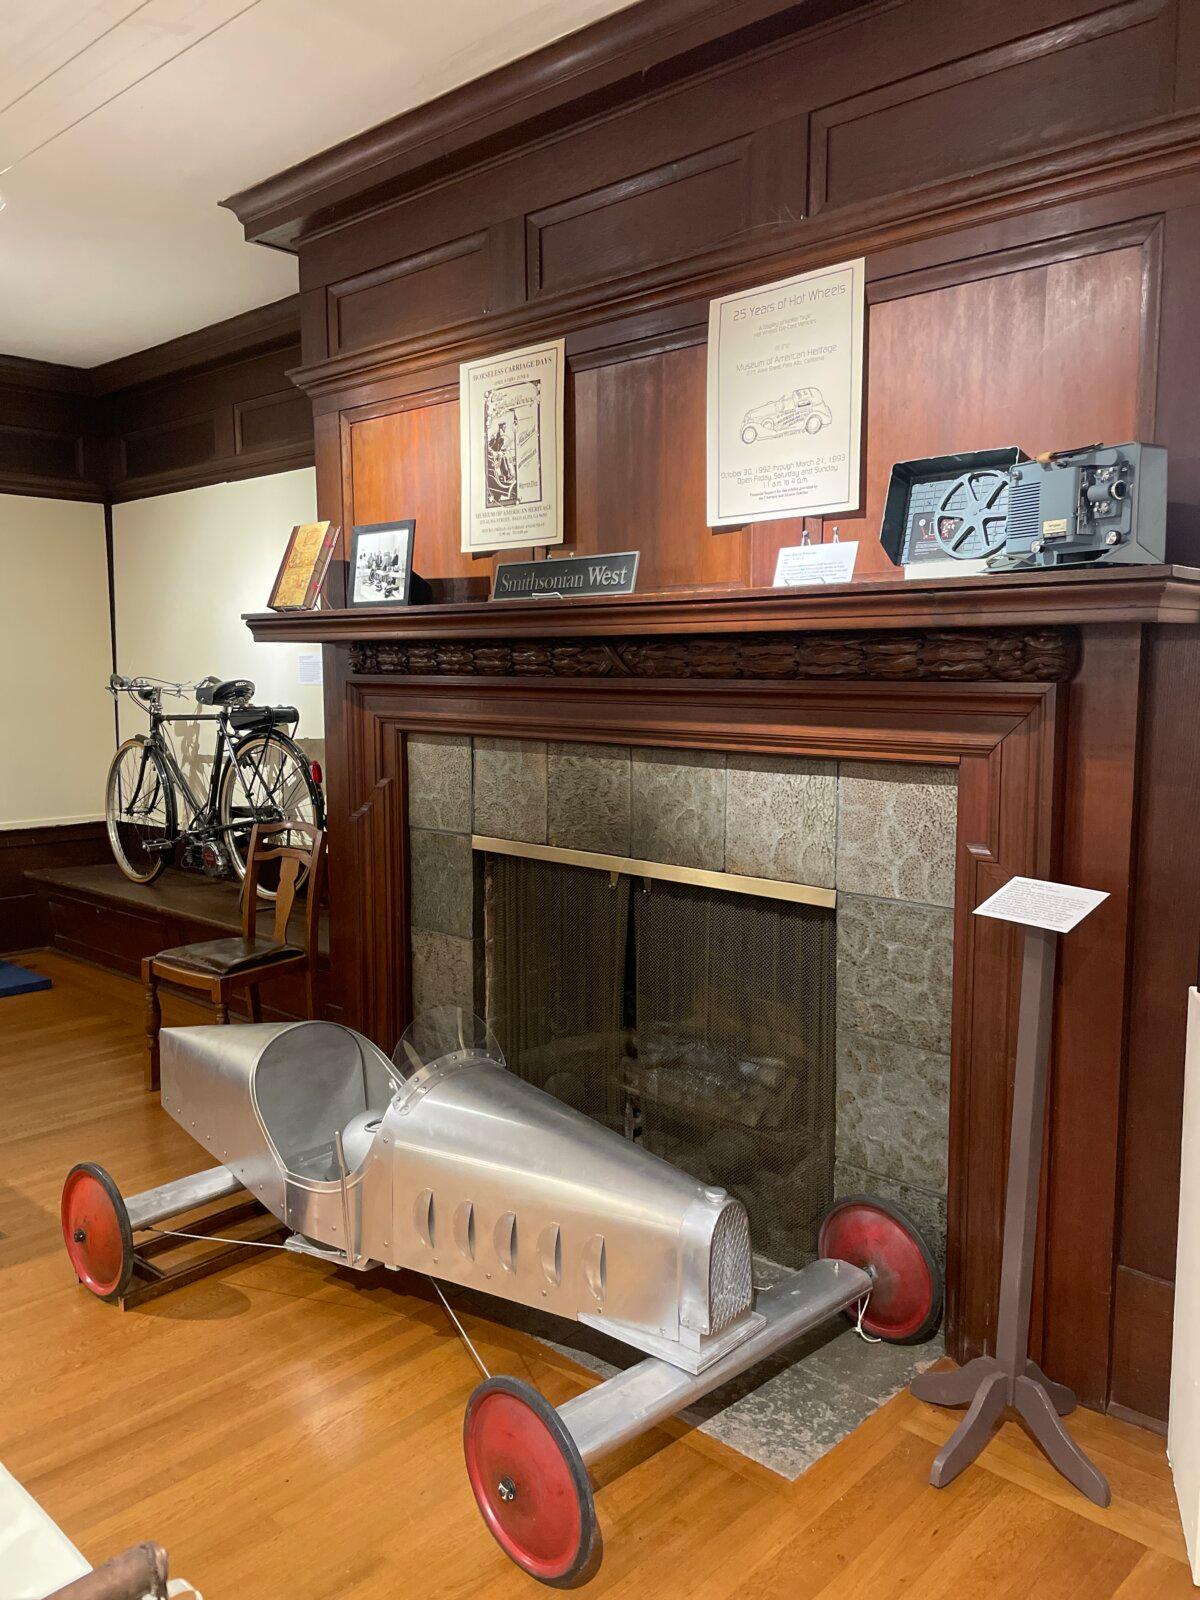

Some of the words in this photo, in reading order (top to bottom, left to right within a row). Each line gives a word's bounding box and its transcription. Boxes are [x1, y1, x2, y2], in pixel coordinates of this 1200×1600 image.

[733, 309, 747, 321] 25
[750, 303, 775, 317] Years
[778, 298, 787, 310] of
[789, 293, 806, 306] Hot
[808, 284, 846, 301] Wheels
[473, 369, 504, 381] HORSELESS
[505, 361, 535, 373] CARRIAGE
[536, 356, 552, 366] DAYS
[736, 360, 765, 372] Museum
[774, 351, 805, 363] American
[807, 344, 838, 357] Heritage
[721, 471, 741, 479] October
[755, 465, 771, 474] 1992
[772, 462, 795, 472] through
[795, 459, 814, 468] March
[829, 453, 846, 463] 1993
[737, 477, 753, 485] Open
[774, 471, 800, 480] Saturday
[814, 464, 838, 473] Sunday
[500, 569, 583, 592] Smithsonian
[588, 565, 627, 586] West
